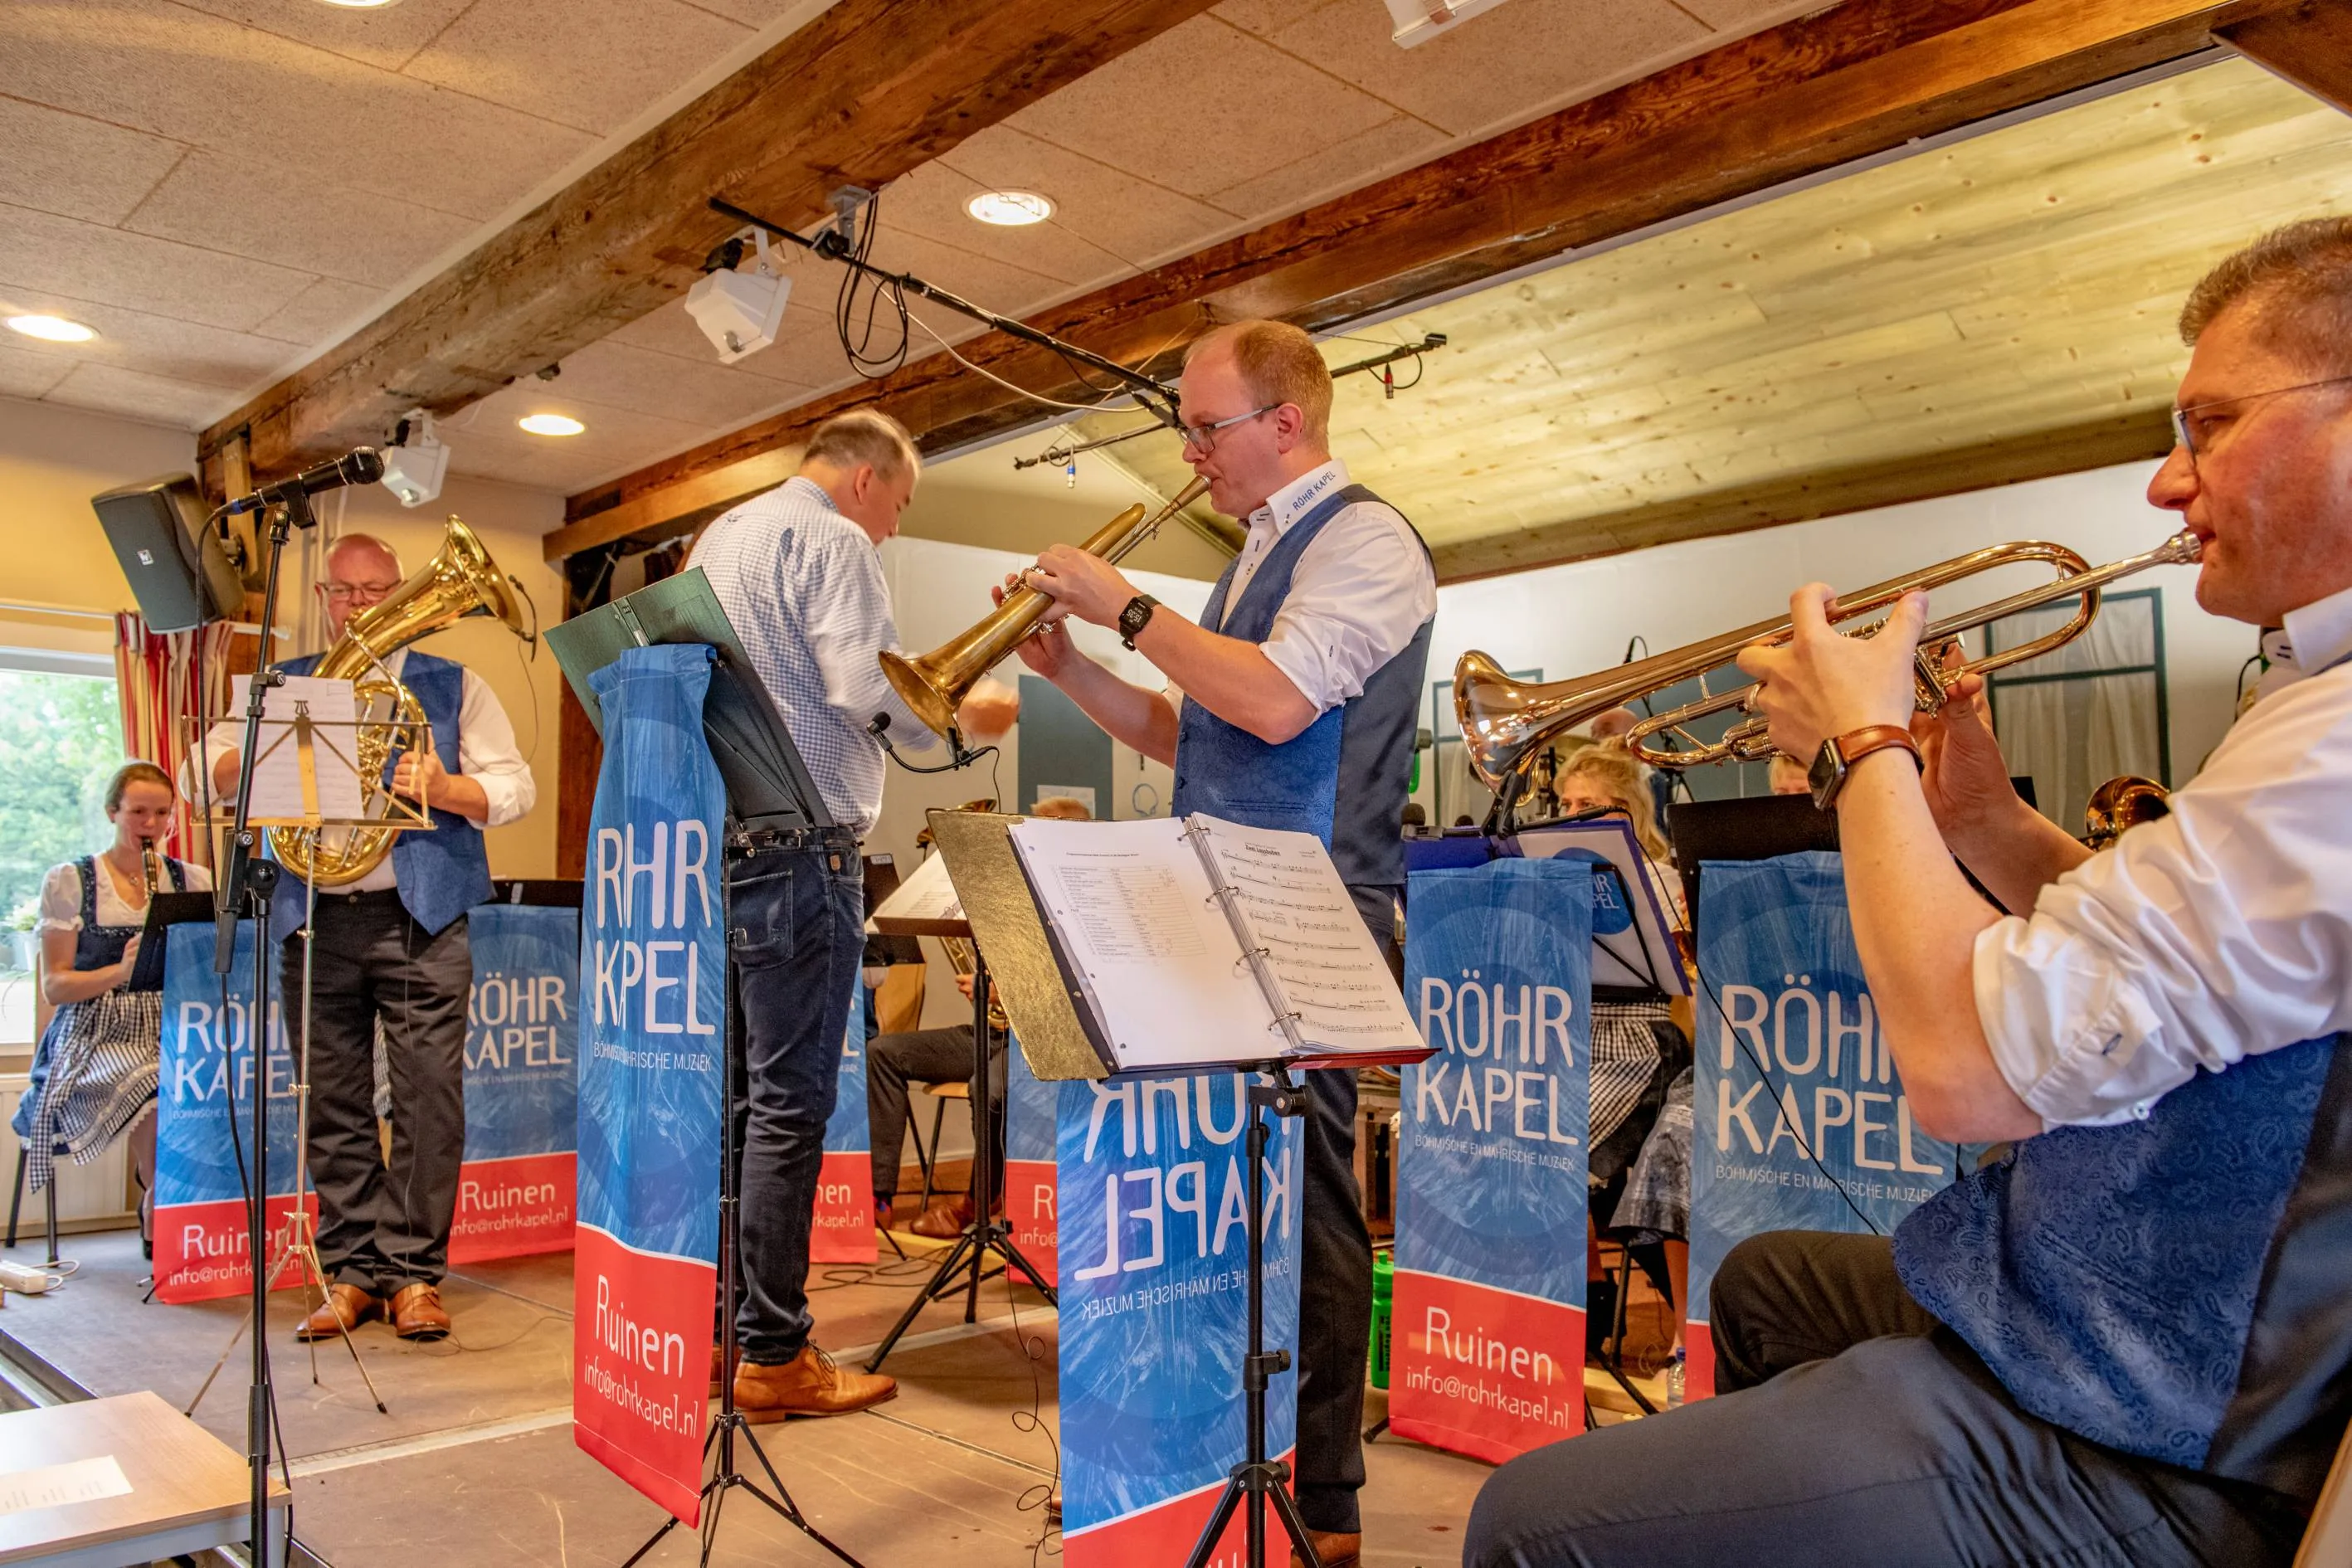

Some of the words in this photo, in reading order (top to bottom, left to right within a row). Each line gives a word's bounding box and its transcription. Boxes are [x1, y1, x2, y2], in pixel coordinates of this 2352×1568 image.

[1313, 470, 1336, 492] KAPEL
[597, 819, 712, 929] RHR
[1593, 892, 1619, 909] PEL
[595, 939, 716, 1035] KPEL
[178, 993, 290, 1054] RÖH
[1420, 968, 1574, 1068] RÖHR
[174, 1055, 296, 1103] KAPE
[674, 1054, 711, 1072] MUZIEK
[1416, 1061, 1579, 1146] KAPEL
[1717, 1079, 1943, 1176] KAPEL
[1538, 1153, 1574, 1171] MUZIEK
[1794, 1173, 1810, 1189] EN
[461, 1181, 555, 1213] Ruinen
[816, 1184, 851, 1205] nen
[183, 1225, 290, 1259] Ruinn
[596, 1274, 684, 1379] Ruinen
[1425, 1306, 1553, 1385] Ruinen
[584, 1355, 699, 1439] info@rohrkapel.nl
[1406, 1366, 1569, 1430] info@rohrkapel.nl
